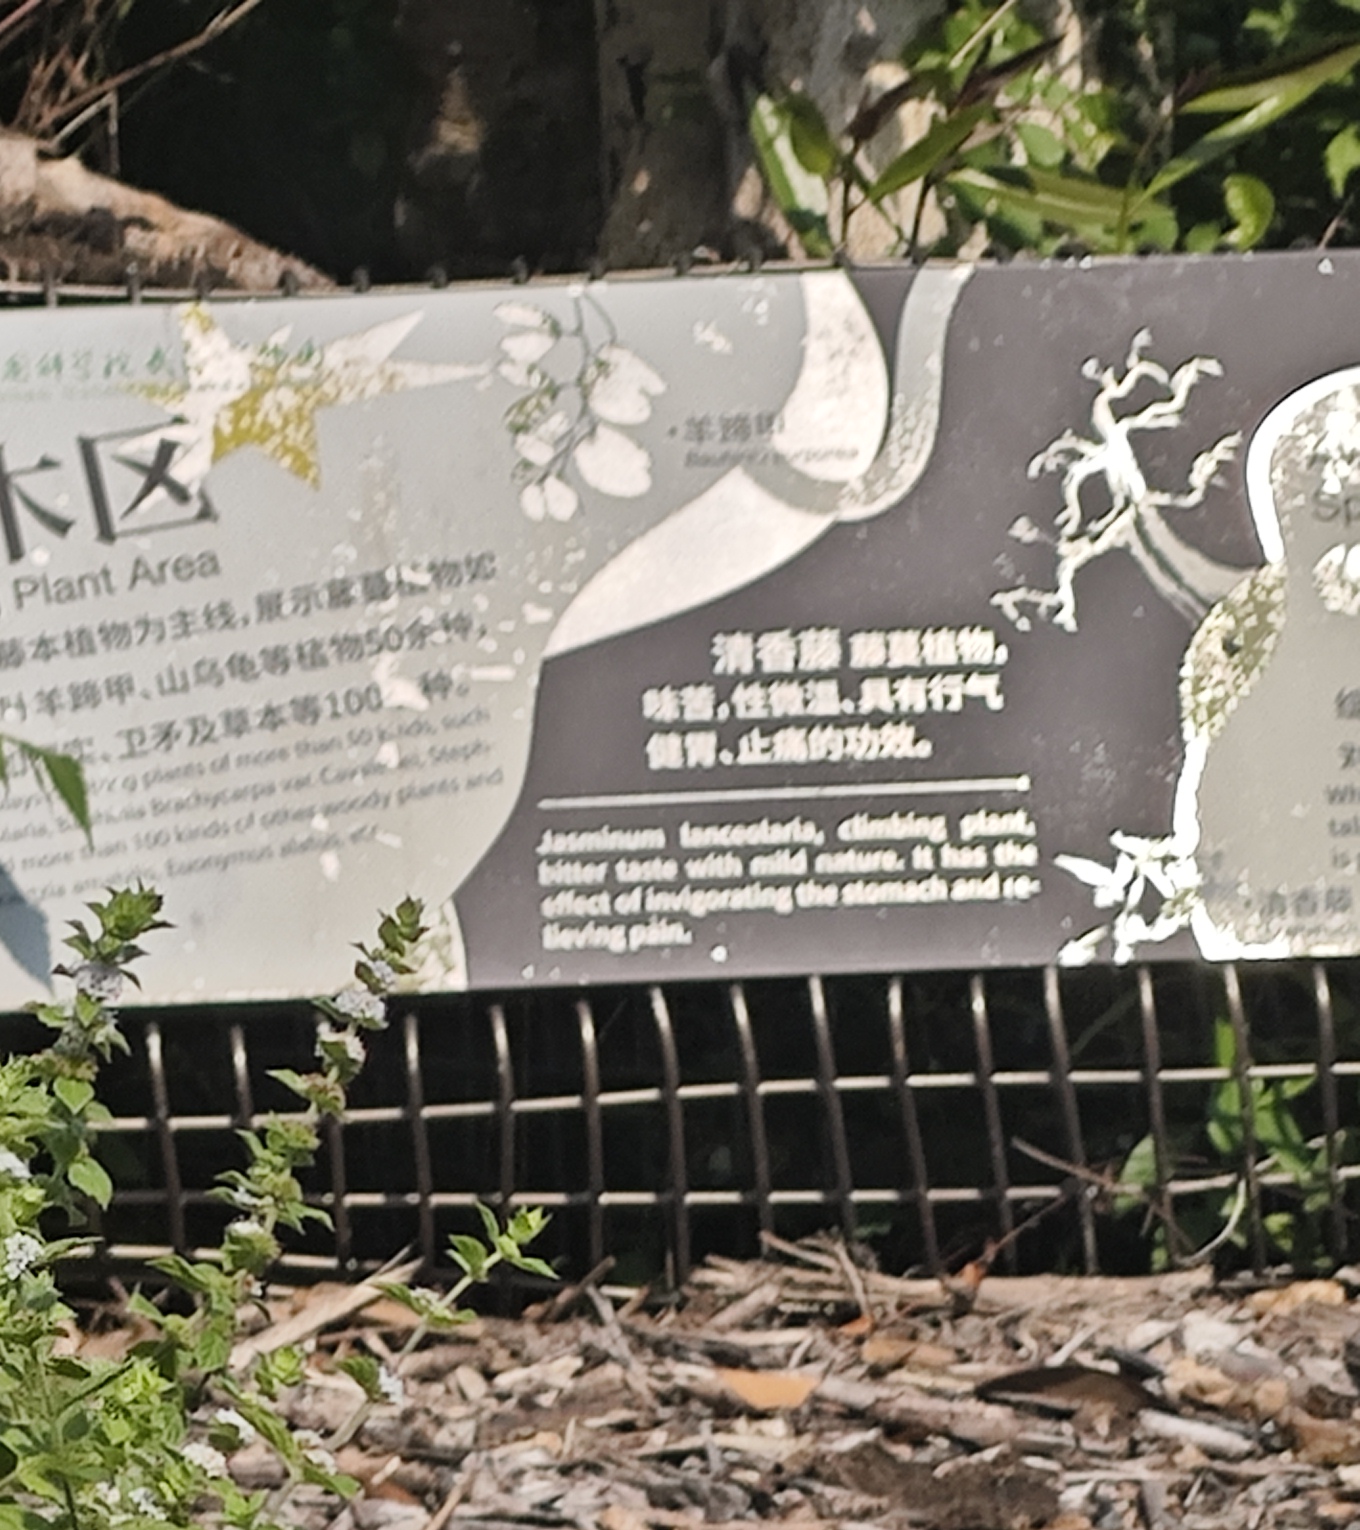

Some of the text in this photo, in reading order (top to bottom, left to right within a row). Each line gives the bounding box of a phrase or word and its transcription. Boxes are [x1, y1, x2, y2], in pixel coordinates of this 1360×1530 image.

[12, 566, 118, 611] Plant
[128, 548, 221, 592] Area
[710, 625, 841, 675] 清香藤
[536, 824, 667, 855] Jasminum
[837, 811, 948, 844] climbing
[538, 859, 609, 887] bitter
[614, 856, 679, 884] taste
[683, 851, 744, 879] with
[749, 848, 808, 877] mild
[940, 842, 988, 869] has
[993, 839, 1039, 868] the
[540, 889, 612, 919] effect
[614, 885, 643, 916] of
[644, 881, 794, 919] invigorating
[794, 878, 839, 909] the
[841, 873, 949, 906] stomach
[950, 870, 1001, 901] and
[542, 919, 628, 954] lieving
